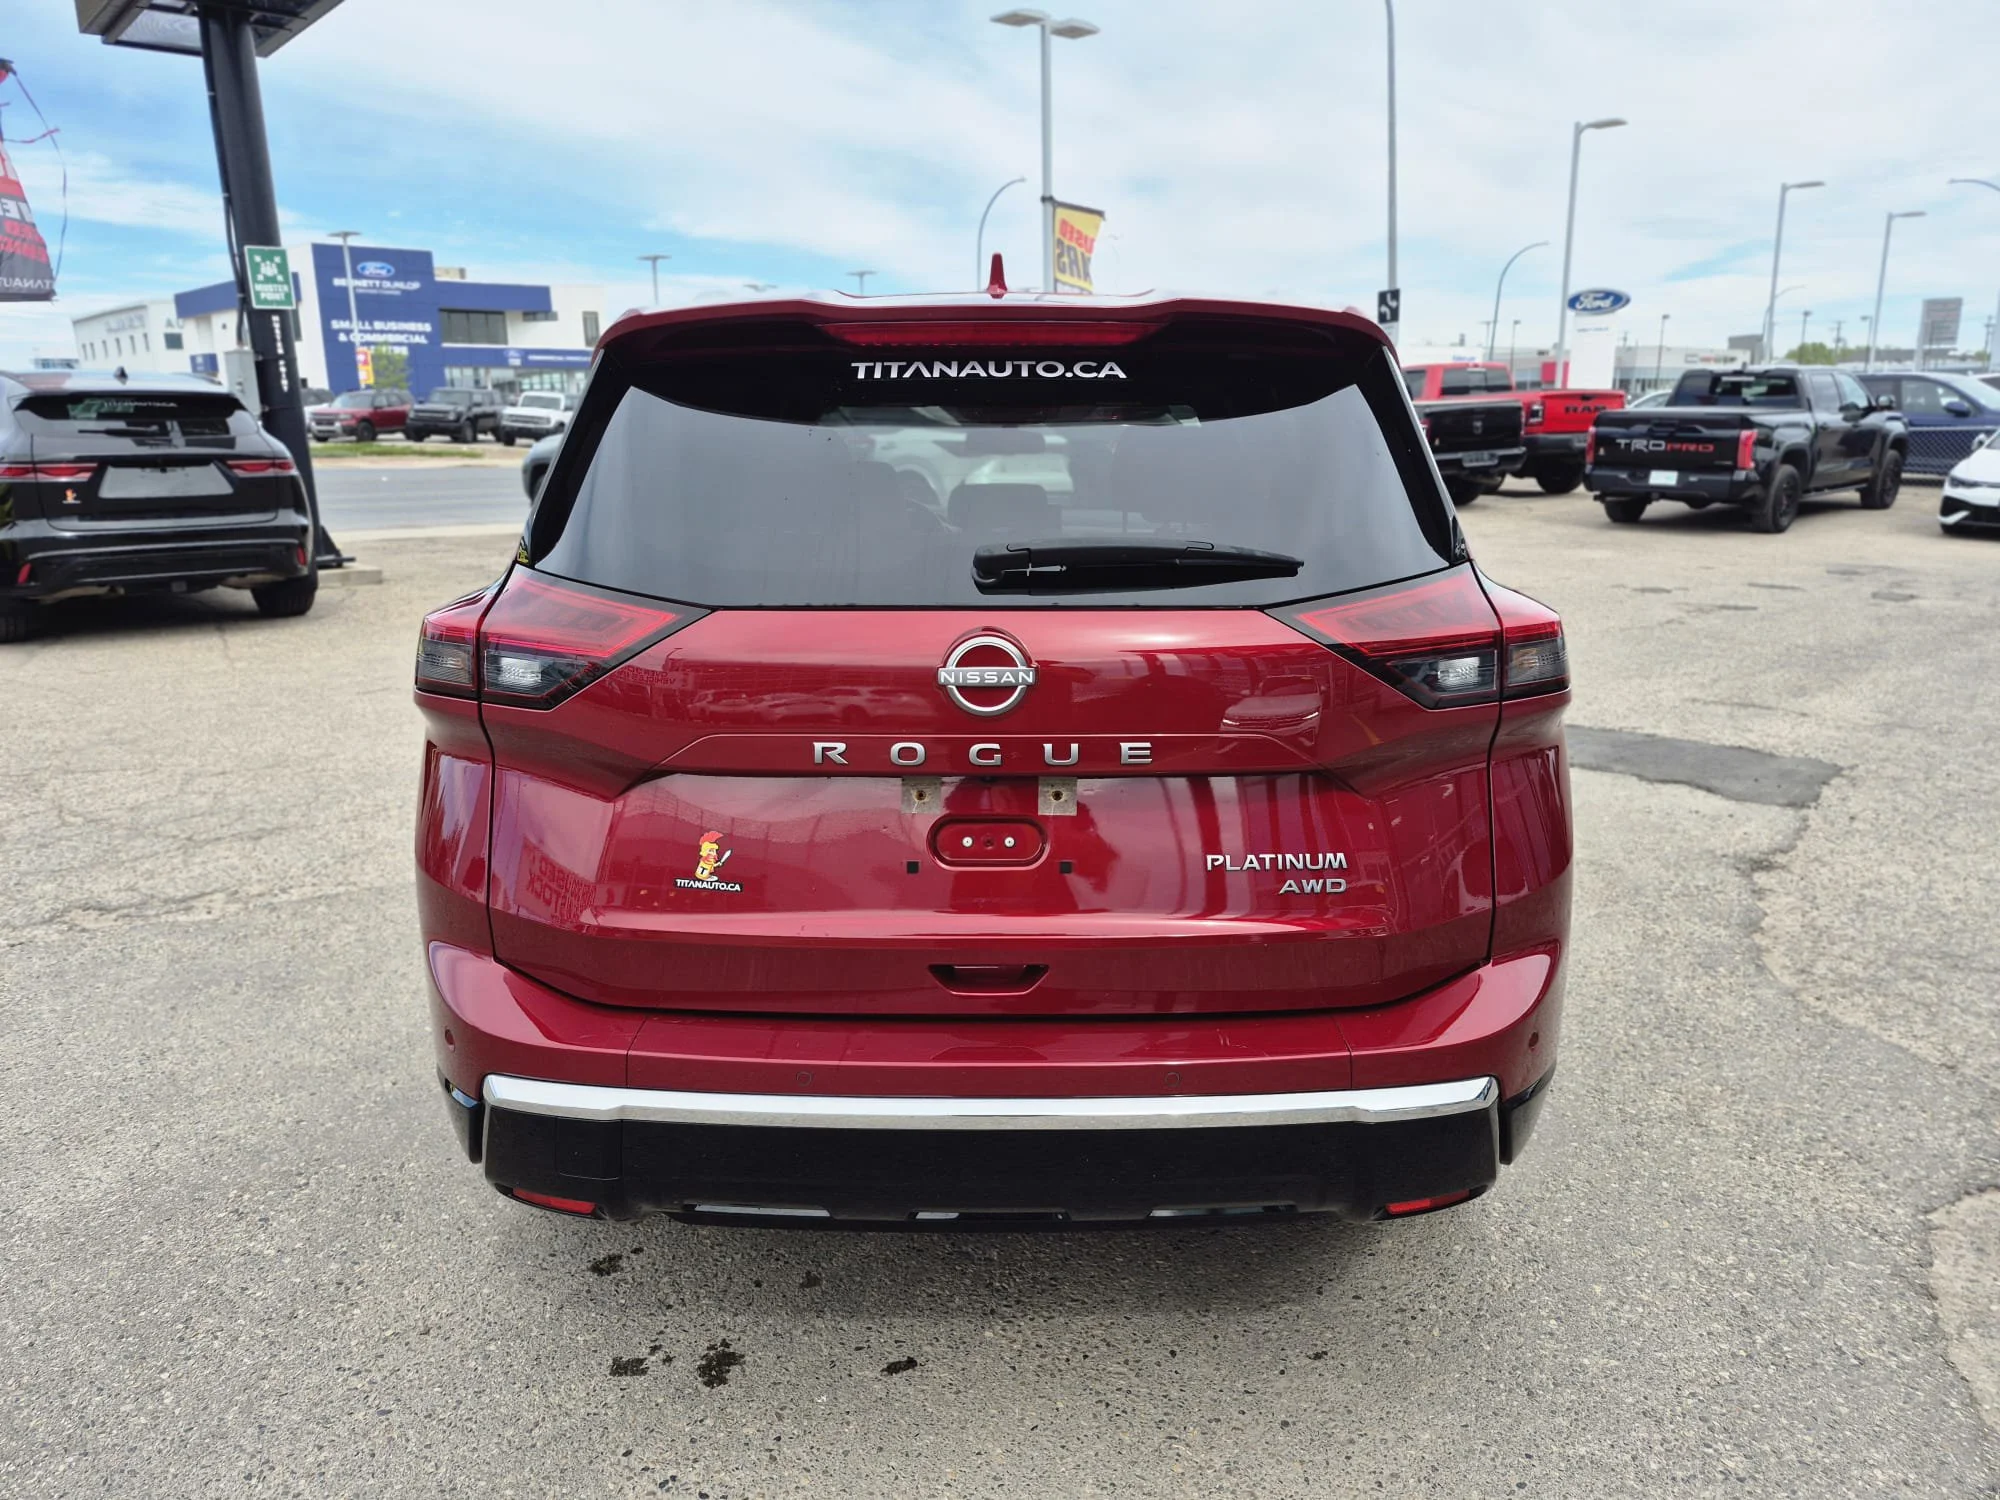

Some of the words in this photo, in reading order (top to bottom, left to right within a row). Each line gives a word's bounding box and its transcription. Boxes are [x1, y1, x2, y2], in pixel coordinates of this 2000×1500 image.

[254, 282, 288, 293] MUSTER
[332, 277, 380, 288] BENETT
[260, 292, 285, 301] POINT
[373, 320, 432, 332] BUSINESS
[851, 360, 1128, 380] TITANAUTO.CA
[1666, 442, 1715, 453] PRO
[940, 670, 1034, 684] NISSAN
[813, 741, 1153, 766] ROGUE
[1206, 853, 1348, 871] PLATINUM
[701, 866, 708, 875] T
[675, 878, 741, 892] TITANAUTO.CA
[1279, 878, 1347, 895] AWD
